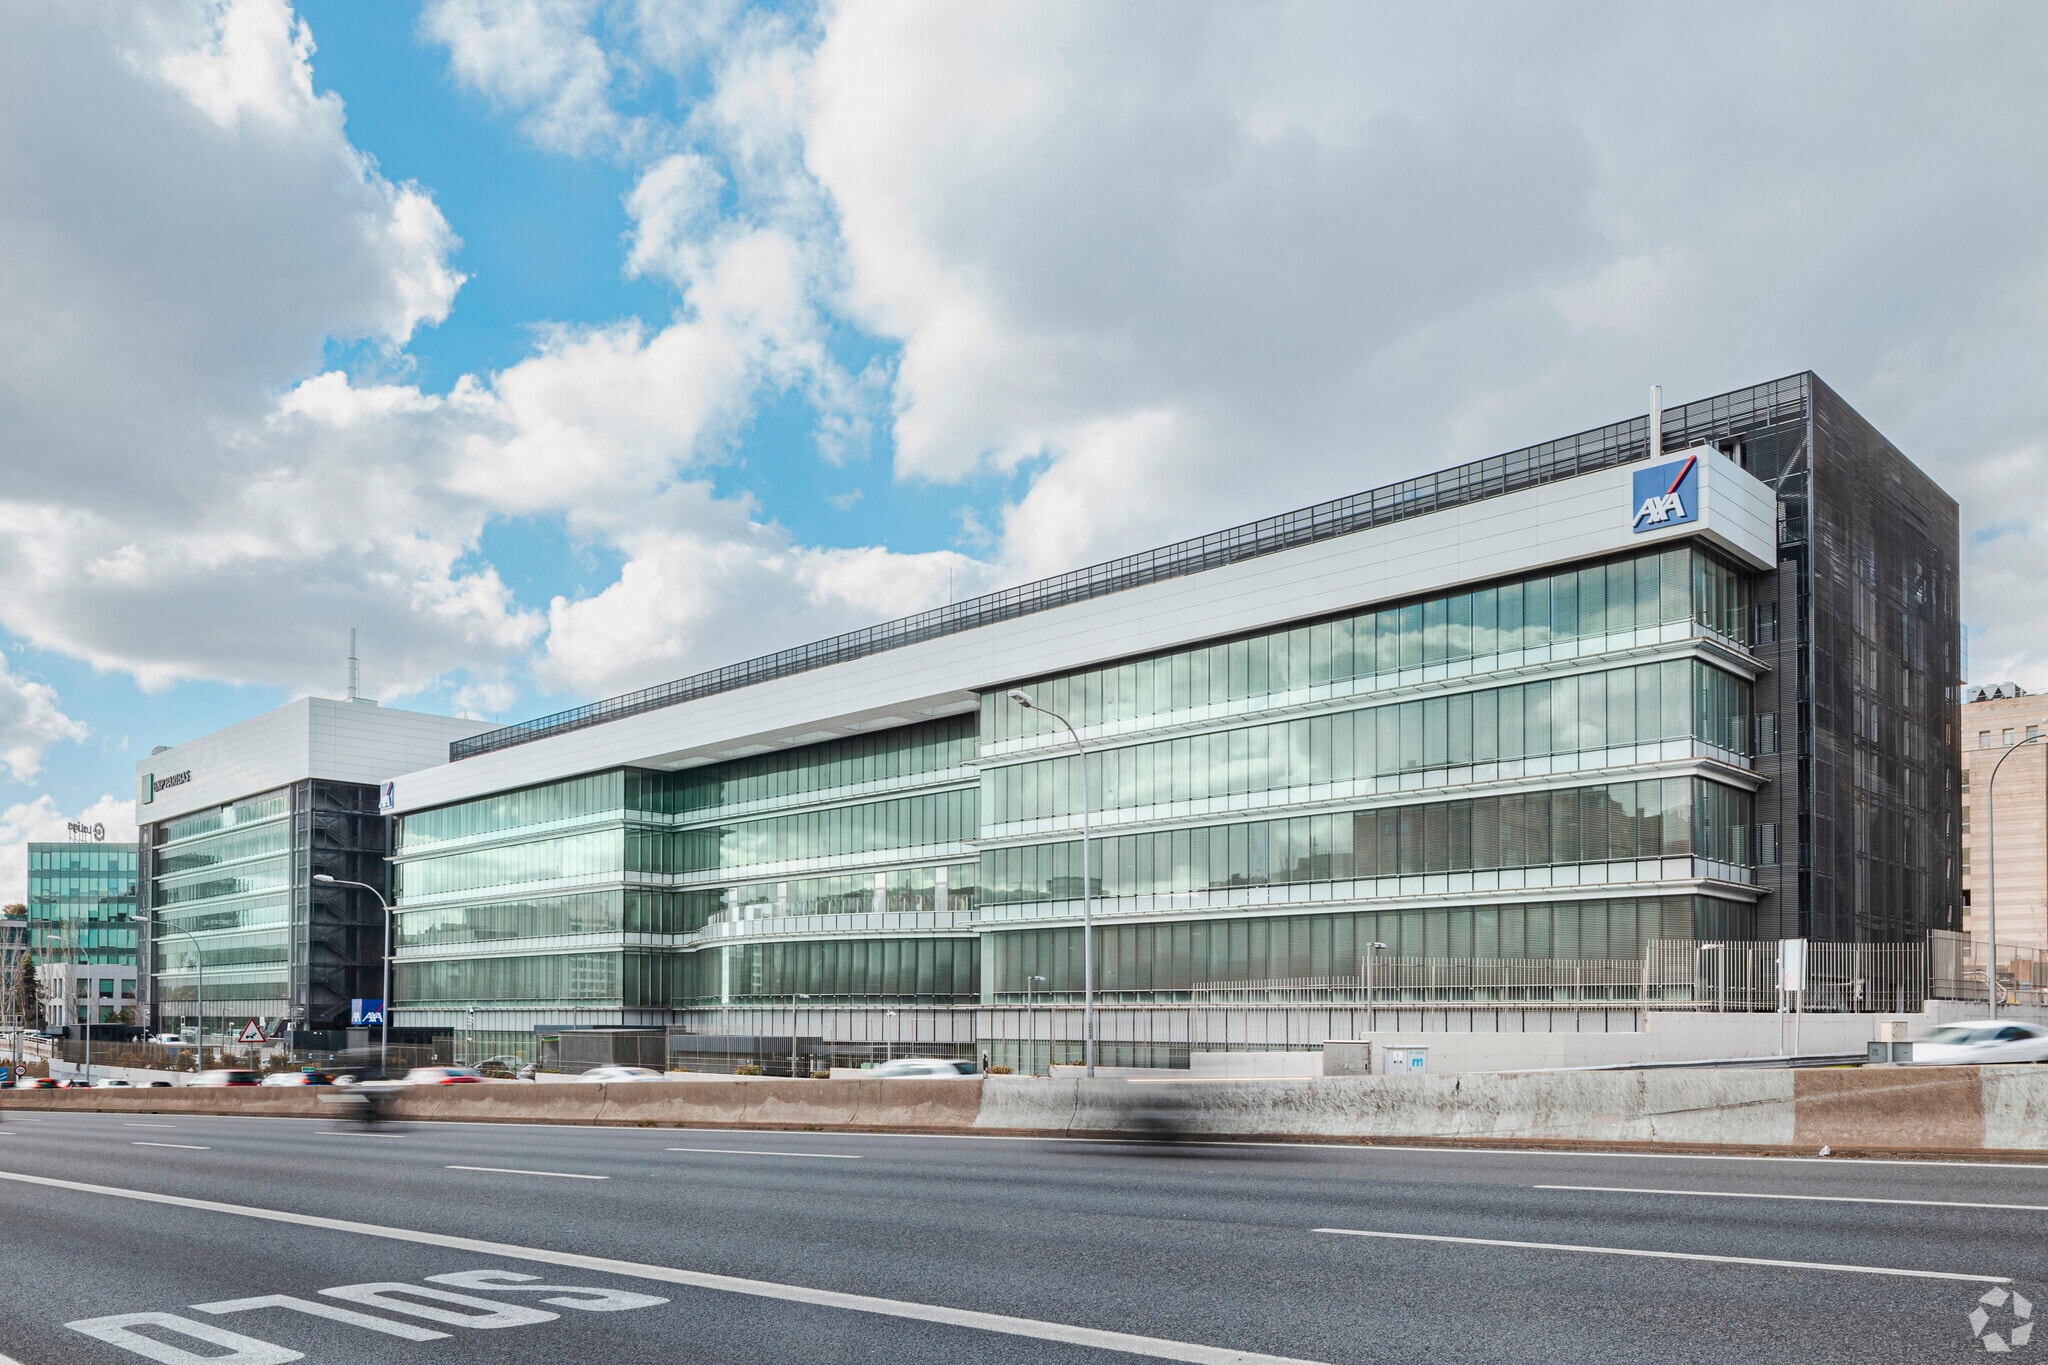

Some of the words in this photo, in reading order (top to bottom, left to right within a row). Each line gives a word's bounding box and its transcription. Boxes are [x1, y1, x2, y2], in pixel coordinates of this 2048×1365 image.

[1633, 492, 1687, 528] AXA
[362, 1011, 384, 1023] AXA
[62, 1268, 671, 1365] SOLO
